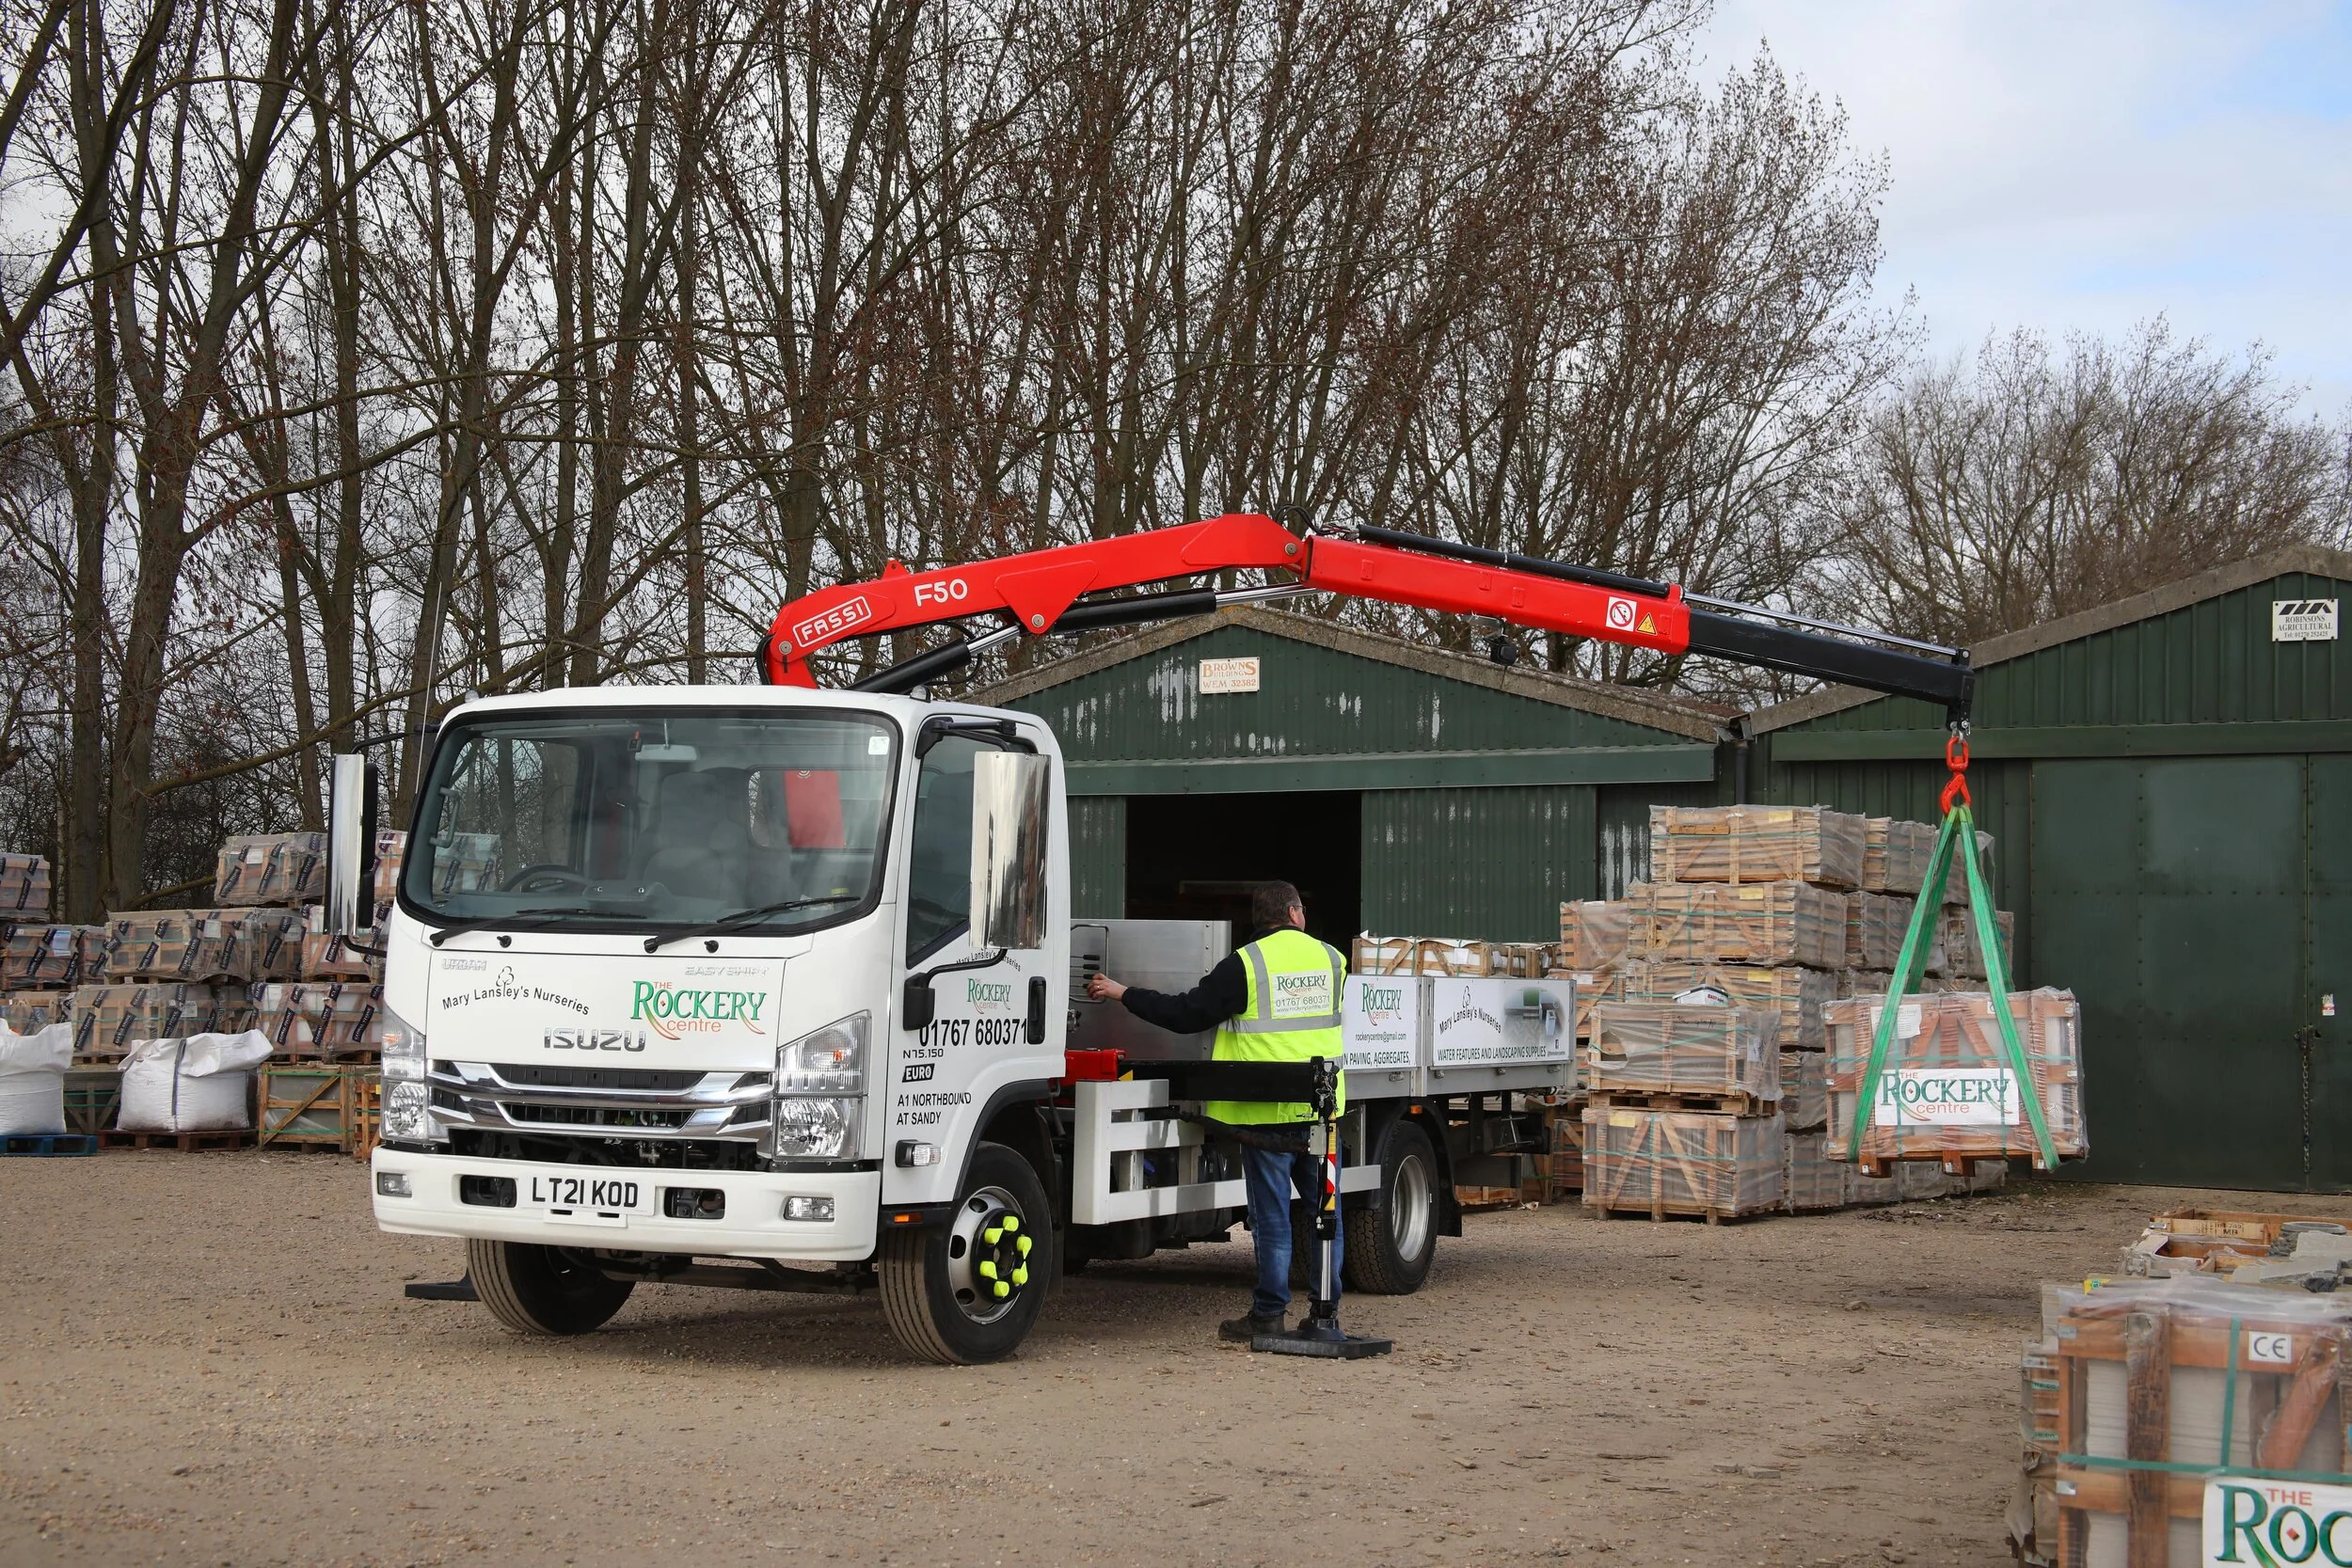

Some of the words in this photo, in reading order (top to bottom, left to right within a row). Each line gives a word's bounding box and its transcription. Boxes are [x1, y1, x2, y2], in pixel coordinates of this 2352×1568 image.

[914, 578, 968, 607] F50
[801, 602, 864, 641] FASSI
[2278, 623, 2333, 631] AGRICULTURAL
[1203, 680, 1227, 689] WEM
[442, 958, 487, 971] URBAN
[1276, 975, 1327, 993] ROCKERY
[442, 993, 470, 1010] Mary
[474, 985, 529, 1000] Lansley's
[533, 987, 590, 1015] Nurseries
[967, 978, 1011, 1008] ROCKERY
[1362, 982, 1402, 1020] ROCKERY
[630, 981, 767, 1034] ROCKERY
[1276, 997, 1299, 1007] 01767
[1373, 1011, 1389, 1019] centre
[1439, 1019, 1452, 1035] Mary
[1453, 1006, 1478, 1023] Lansley's
[1478, 1007, 1502, 1033] Nurseries
[667, 1019, 721, 1032] centre
[919, 1019, 970, 1046] 01767
[976, 1019, 1027, 1045] 680371
[544, 1027, 646, 1052] ISUZU
[903, 1048, 944, 1059] N75.150
[1350, 1052, 1372, 1066] PAVING,
[1374, 1051, 1411, 1065] AGGREGATES,
[1438, 1049, 1455, 1061] WATER
[1456, 1048, 1480, 1061] FEATURES
[1481, 1047, 1492, 1059] AND
[1493, 1047, 1525, 1059] LANDSCAPING
[1526, 1046, 1546, 1057] SUPPLIES
[898, 1094, 909, 1107] A1
[913, 1092, 971, 1107] NORTHBOUND
[1880, 1072, 2011, 1116] ROCKERY
[1916, 1102, 1970, 1115] centre
[897, 1113, 909, 1125] AT
[911, 1111, 941, 1125] SANDY
[532, 1177, 585, 1204] LT21
[592, 1180, 638, 1208] KOD
[2265, 1488, 2313, 1505] THE
